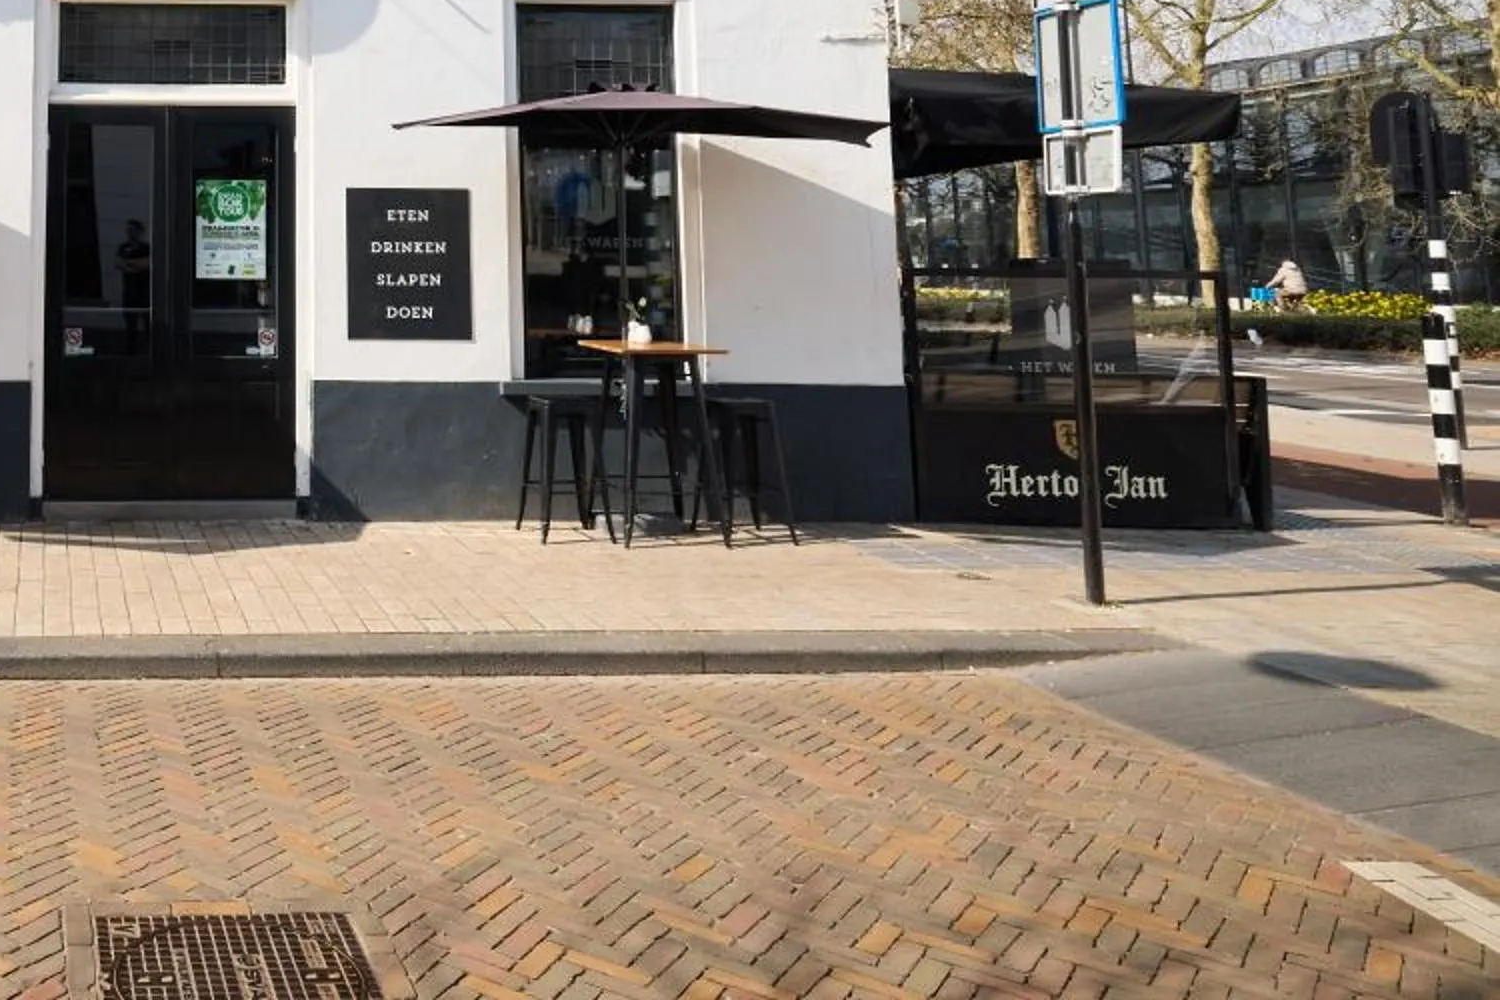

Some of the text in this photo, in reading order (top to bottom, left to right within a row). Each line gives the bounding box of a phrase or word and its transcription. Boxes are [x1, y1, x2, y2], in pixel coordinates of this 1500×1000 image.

[386, 209, 429, 222] ETEN
[371, 241, 447, 254] DRINKEN
[376, 273, 442, 287] SLAPEN
[386, 306, 434, 319] DOEN
[1020, 361, 1116, 374] HET WEN
[985, 463, 1168, 509] Herto Jan
